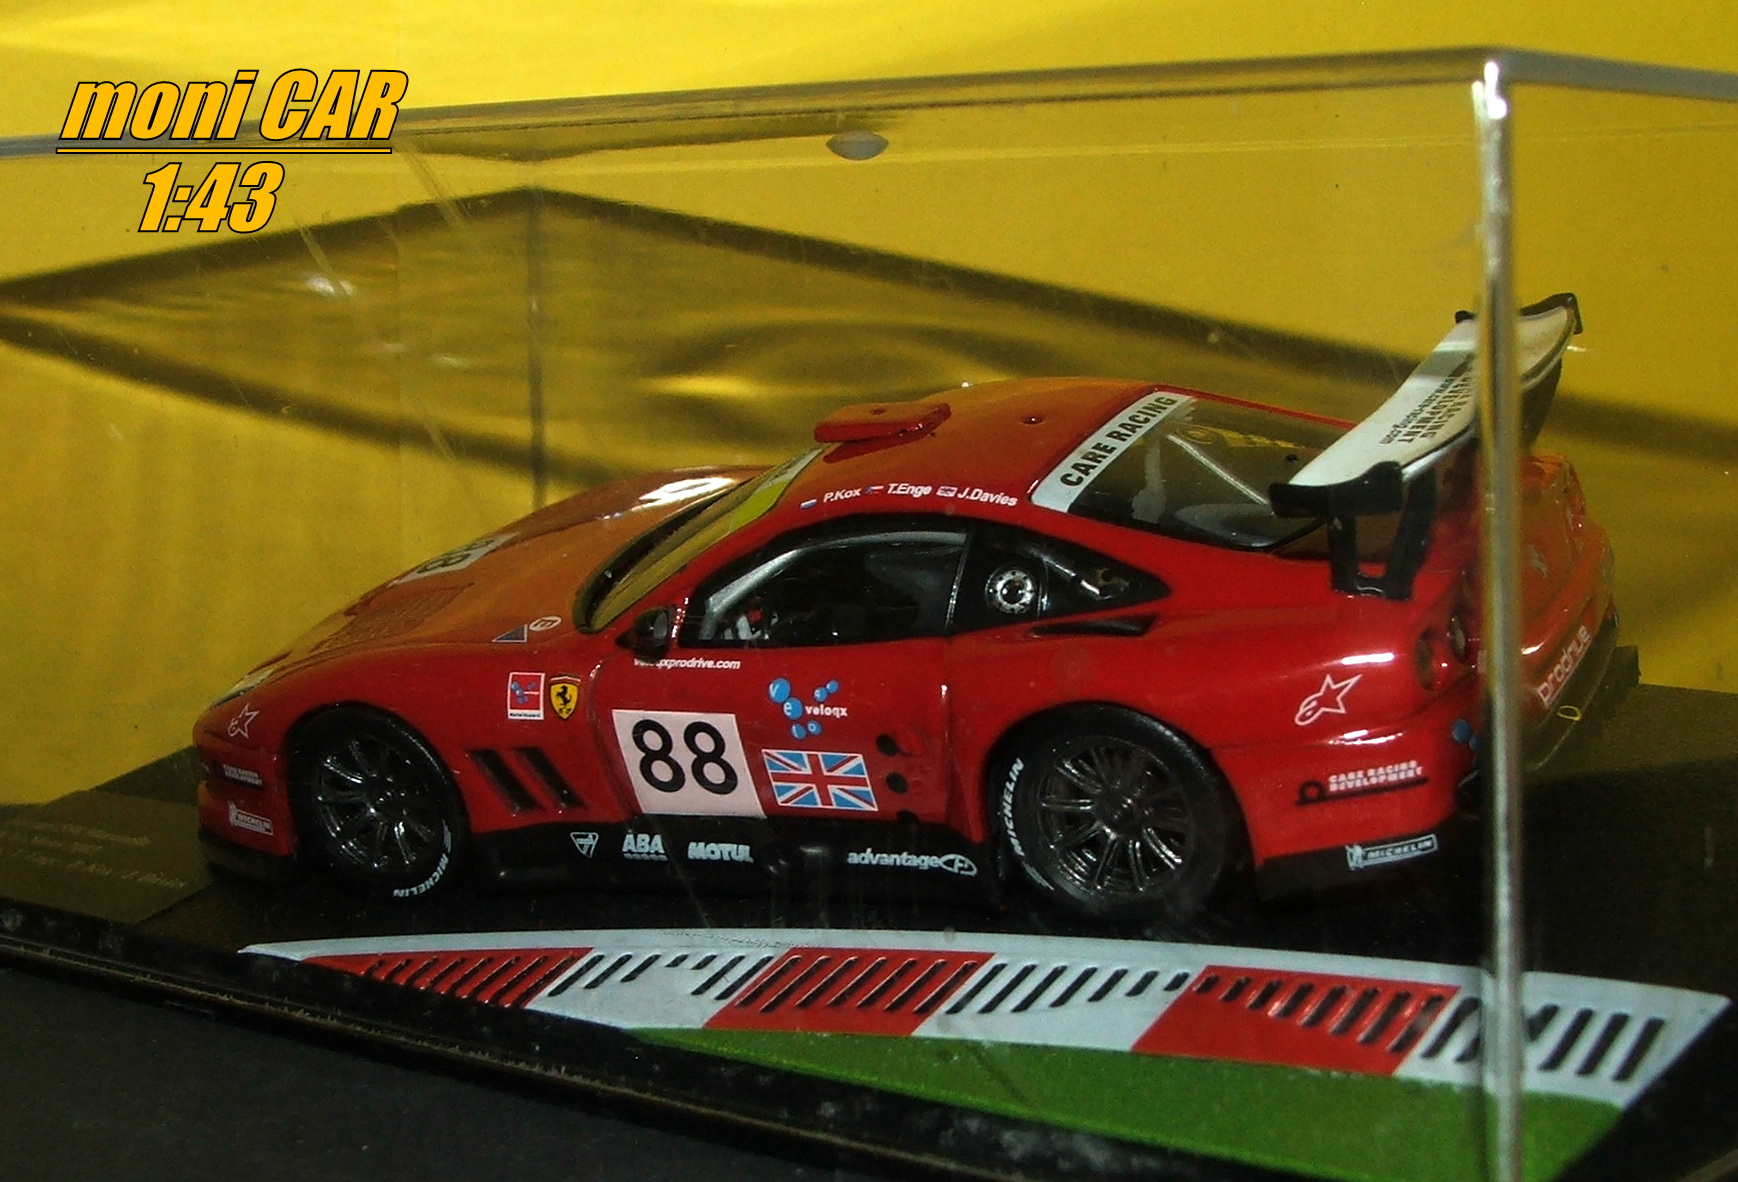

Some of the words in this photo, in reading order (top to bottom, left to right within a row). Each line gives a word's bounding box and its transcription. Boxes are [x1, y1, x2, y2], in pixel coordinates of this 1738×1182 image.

[1060, 442, 1117, 486] CARE
[1105, 396, 1178, 442] RACING
[805, 704, 848, 718] veloqx
[632, 718, 738, 795] 88
[1002, 757, 1025, 857] MICHELIN
[622, 834, 665, 854] ABA
[687, 841, 754, 862] MOTUL
[847, 848, 941, 870] advantage
[393, 853, 449, 898] MICHELIN
